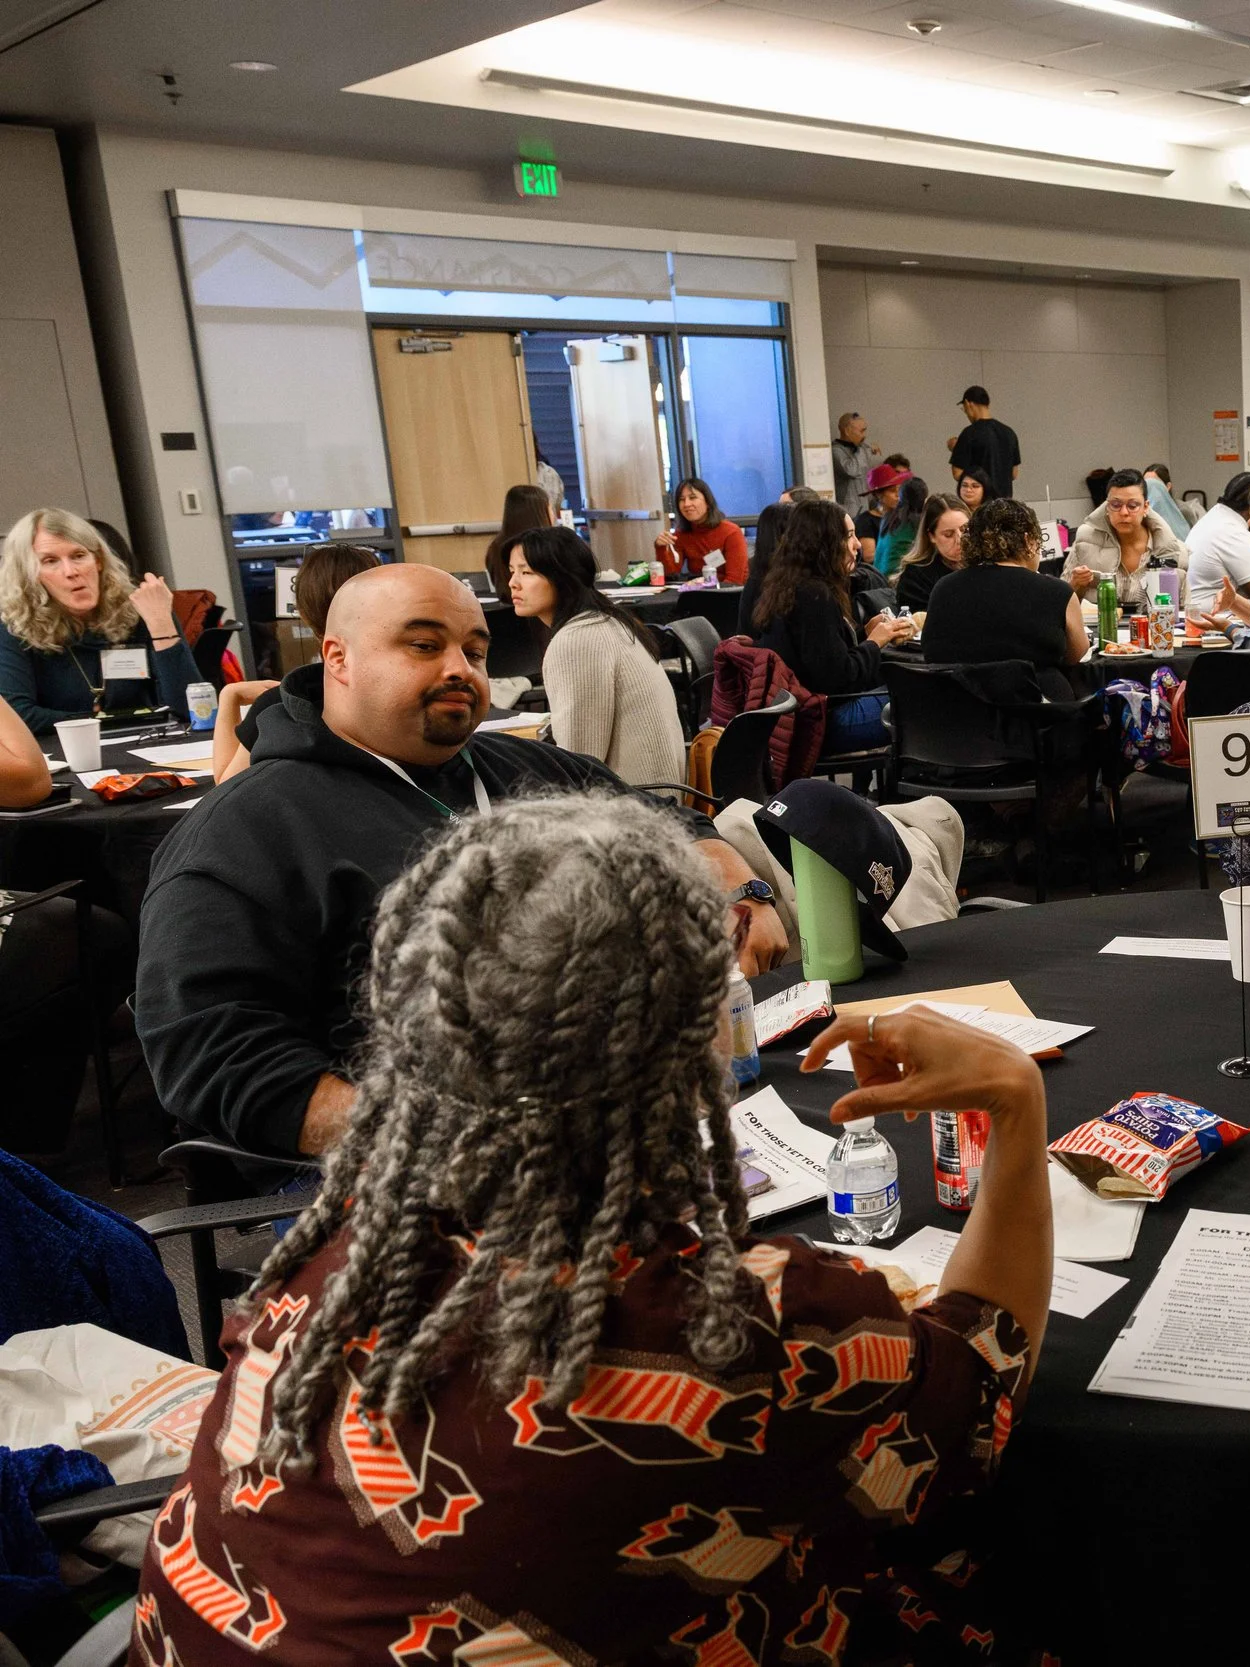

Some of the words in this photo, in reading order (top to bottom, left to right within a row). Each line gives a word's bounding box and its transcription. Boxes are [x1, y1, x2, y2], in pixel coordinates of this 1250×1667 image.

[521, 161, 557, 198] EXIT
[1115, 1113, 1160, 1141] POTATO
[1125, 1110, 1161, 1132] CHIPS
[745, 1111, 763, 1129] FOR
[761, 1127, 788, 1149] THOSE
[786, 1146, 804, 1159] YET
[802, 1156, 815, 1166] TO
[812, 1163, 827, 1176] CO
[1099, 1127, 1141, 1151] Tim's
[1147, 1161, 1163, 1173] 210
[1199, 1227, 1231, 1235] FOR
[1170, 1369, 1216, 1378] WELLNESS
